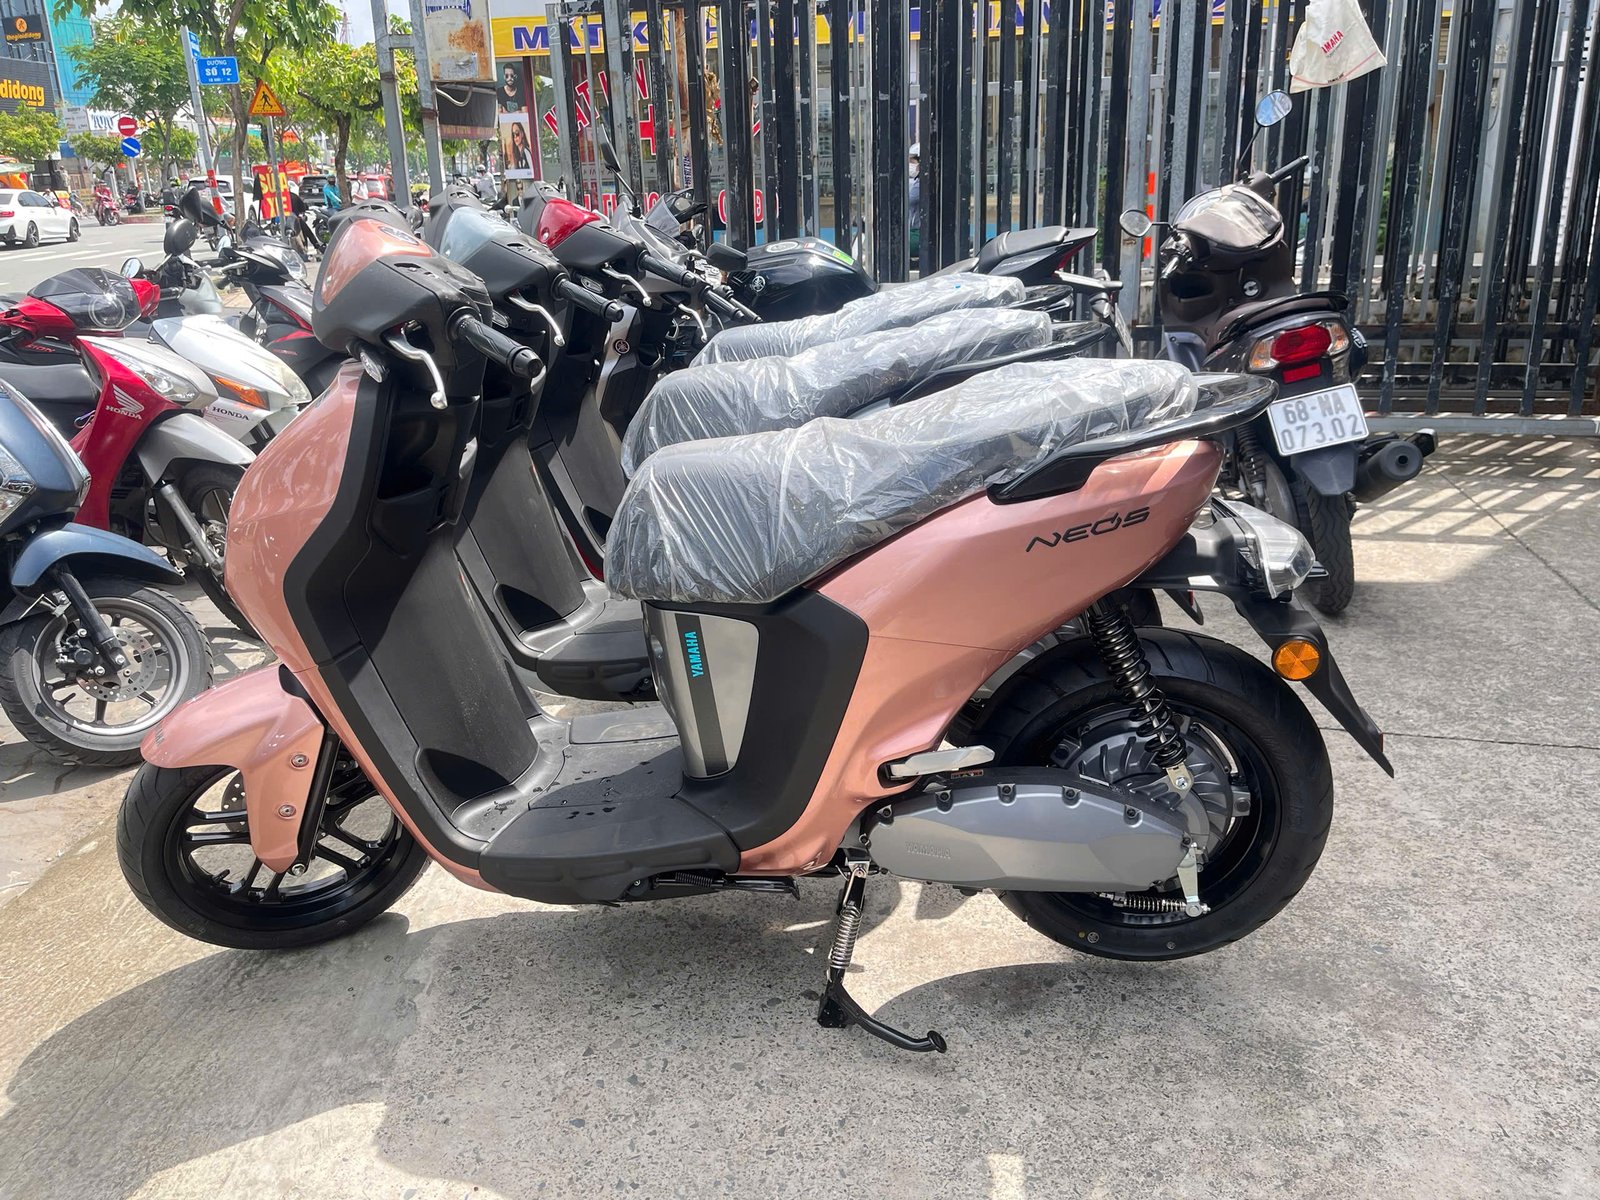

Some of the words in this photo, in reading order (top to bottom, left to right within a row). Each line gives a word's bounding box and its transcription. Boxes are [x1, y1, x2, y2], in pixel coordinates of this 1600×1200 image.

[205, 65, 218, 76] SỐ
[221, 67, 233, 76] 12
[105, 404, 143, 420] HONDA
[212, 405, 250, 421] HONDA
[1280, 414, 1363, 451] 073.02
[1025, 506, 1150, 553] NEOS
[684, 630, 704, 679] YAMAHA
